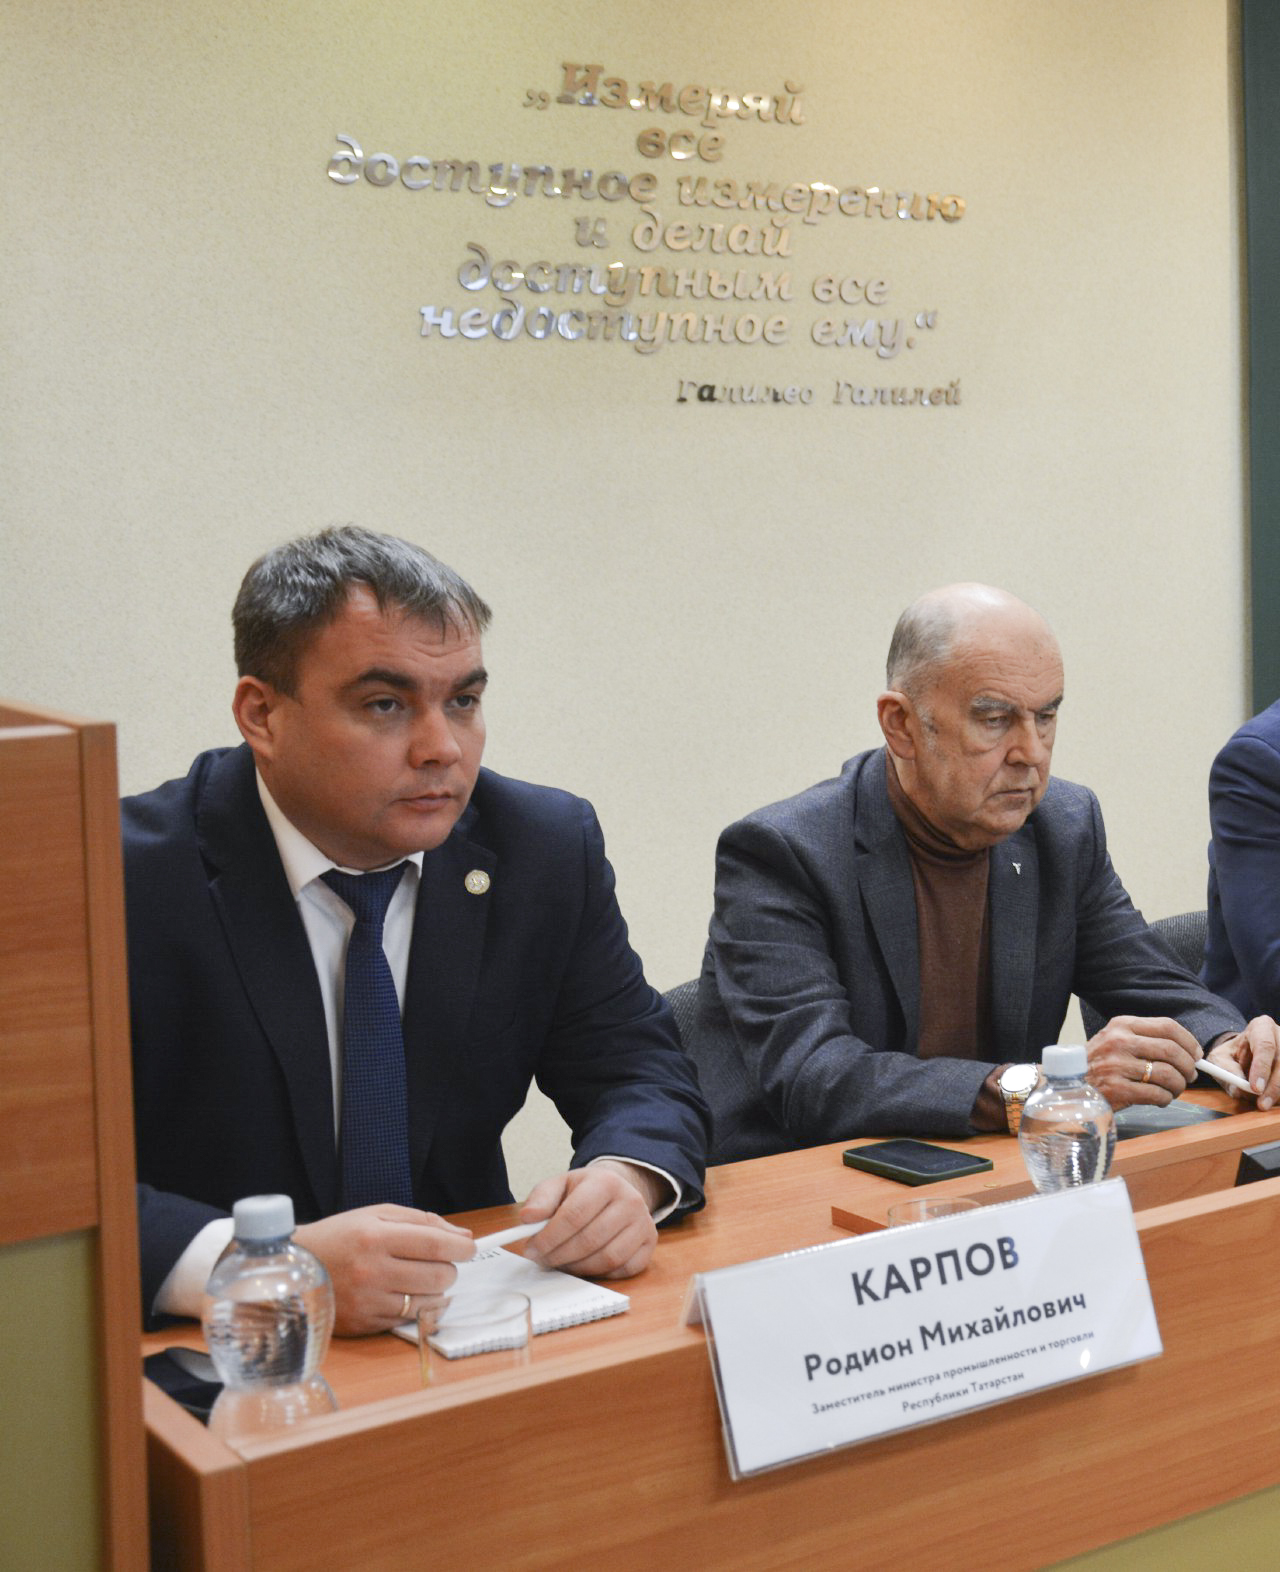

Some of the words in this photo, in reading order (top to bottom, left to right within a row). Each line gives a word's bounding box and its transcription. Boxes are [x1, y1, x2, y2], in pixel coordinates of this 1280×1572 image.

[637, 126, 725, 161] все
[326, 134, 659, 207] доступное
[677, 174, 967, 224] измерению
[574, 213, 609, 248] и
[632, 207, 794, 259] делай
[457, 242, 794, 308] доступным
[813, 274, 891, 306] все
[419, 298, 789, 354] недоступное
[677, 379, 817, 405] Галилео
[833, 378, 963, 406] Галилей
[852, 1236, 1019, 1306] КАРПОВ
[804, 1337, 913, 1382] Родион
[919, 1292, 1087, 1352] Михайлович
[812, 1388, 885, 1415] Заместитель
[888, 1372, 941, 1394] министра
[943, 1346, 1038, 1380] промышленности
[1039, 1343, 1047, 1352] и
[1048, 1331, 1095, 1351] торговли
[902, 1386, 969, 1413] Республики
[971, 1371, 1025, 1394] Татарстан
